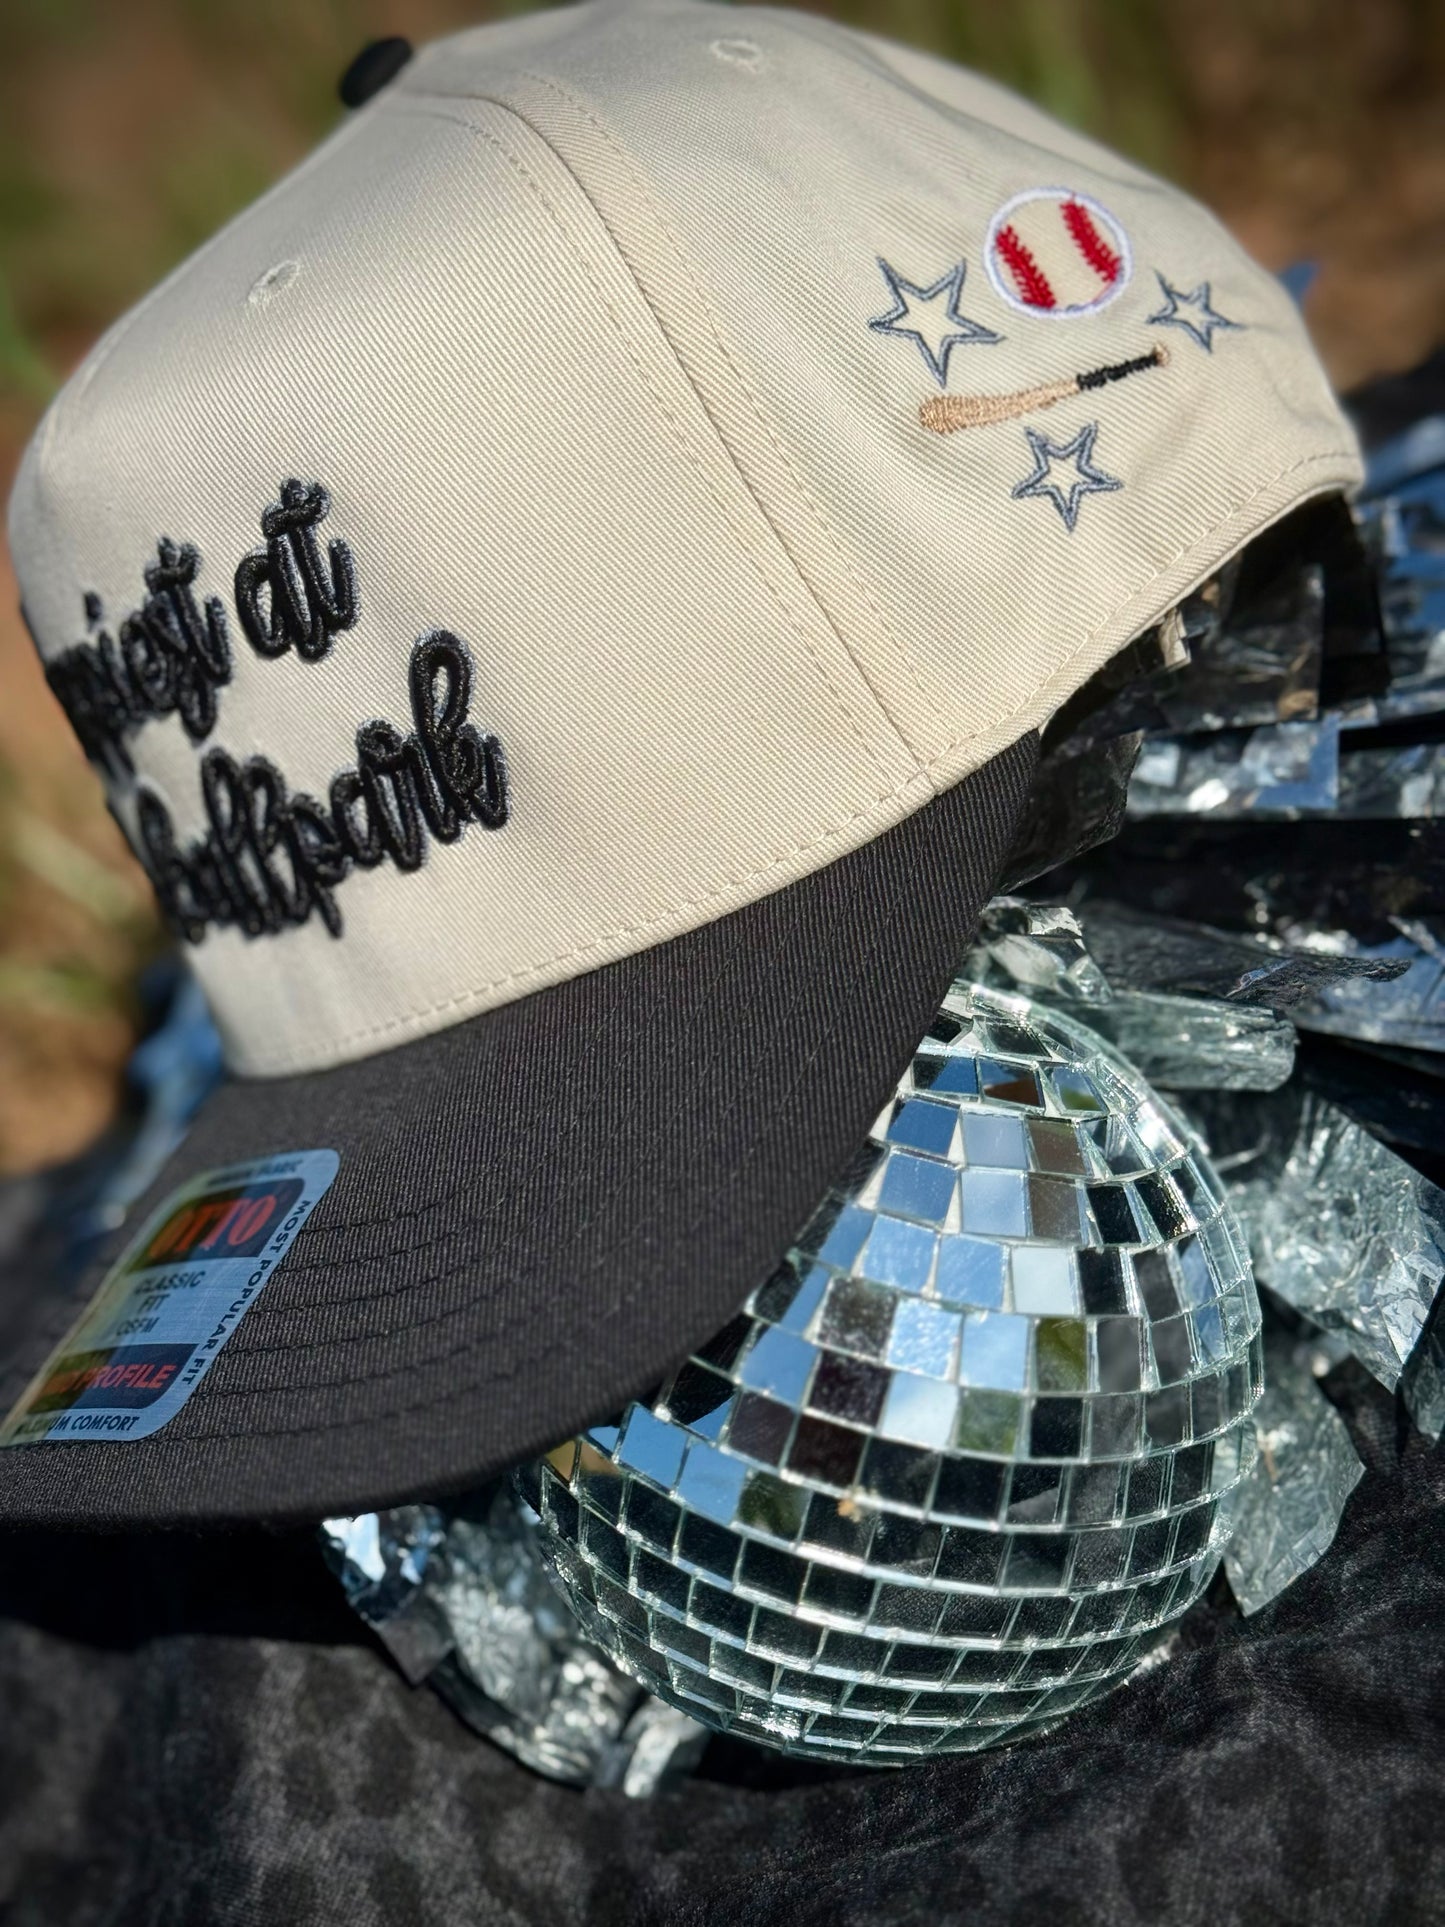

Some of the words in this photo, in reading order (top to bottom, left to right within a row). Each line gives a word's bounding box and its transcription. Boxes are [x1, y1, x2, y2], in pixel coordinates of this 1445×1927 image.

[234, 477, 362, 663] at
[136, 630, 513, 944] ballpark
[147, 1195, 277, 1257] OTTO
[272, 1199, 312, 1256] MOST
[131, 1270, 206, 1296] CLASSIC
[137, 1294, 170, 1313] FIT
[201, 1258, 275, 1353] POPULAR
[71, 1363, 178, 1389] PROFILE
[180, 1357, 209, 1386] FIT
[70, 1414, 141, 1433] COMFORT
